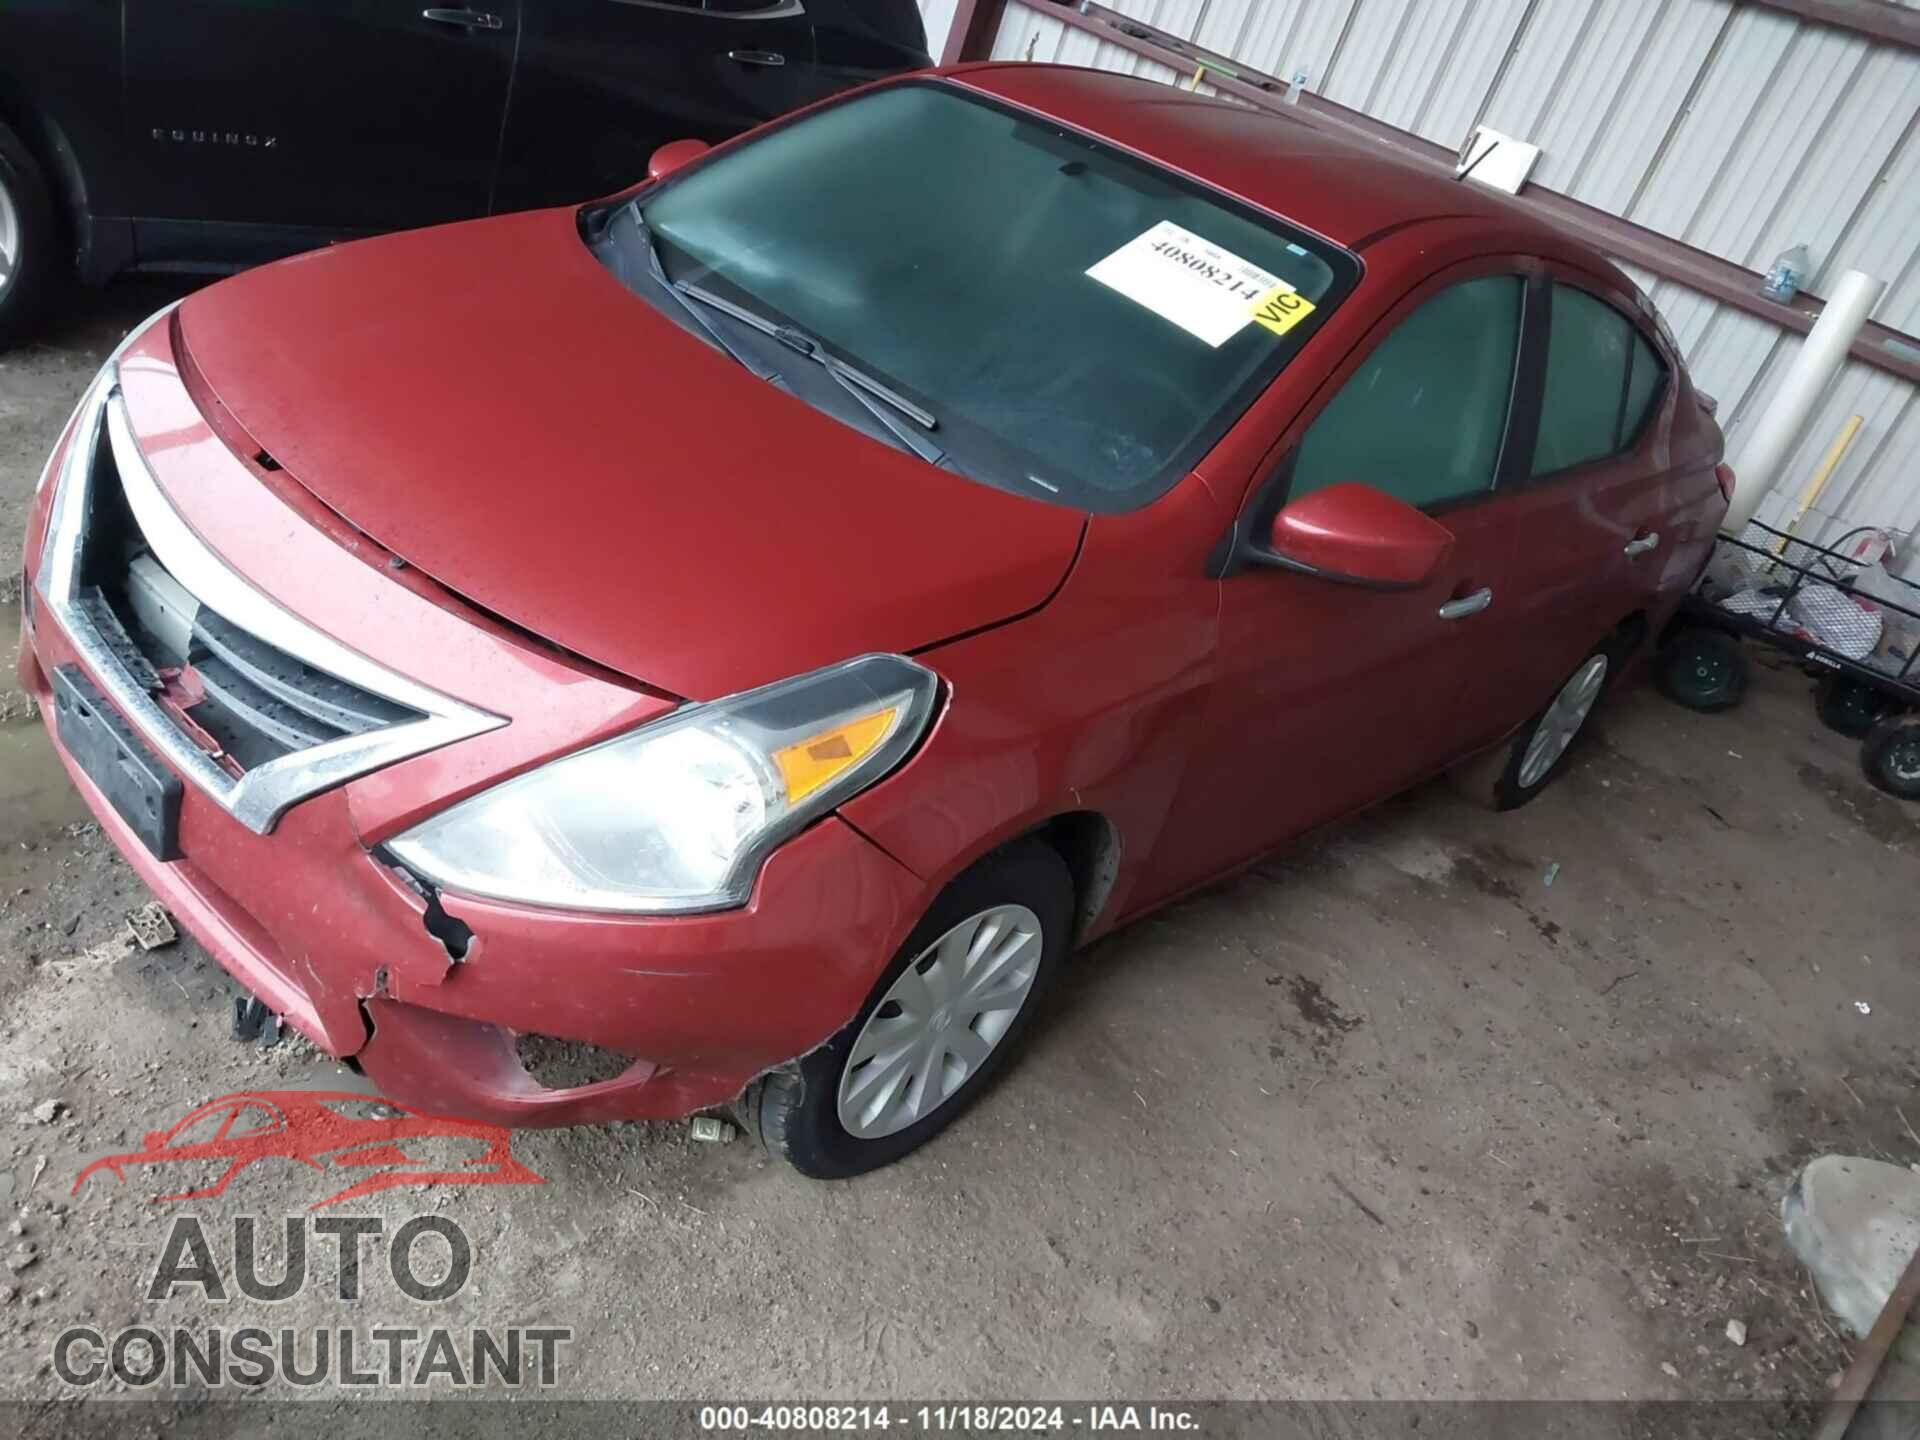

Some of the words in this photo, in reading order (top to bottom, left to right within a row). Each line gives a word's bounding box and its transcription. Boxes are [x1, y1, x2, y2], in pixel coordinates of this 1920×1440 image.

[151, 127, 277, 148] EQUINOX
[1151, 241, 1260, 300] 40808214
[1256, 293, 1301, 323] VIC
